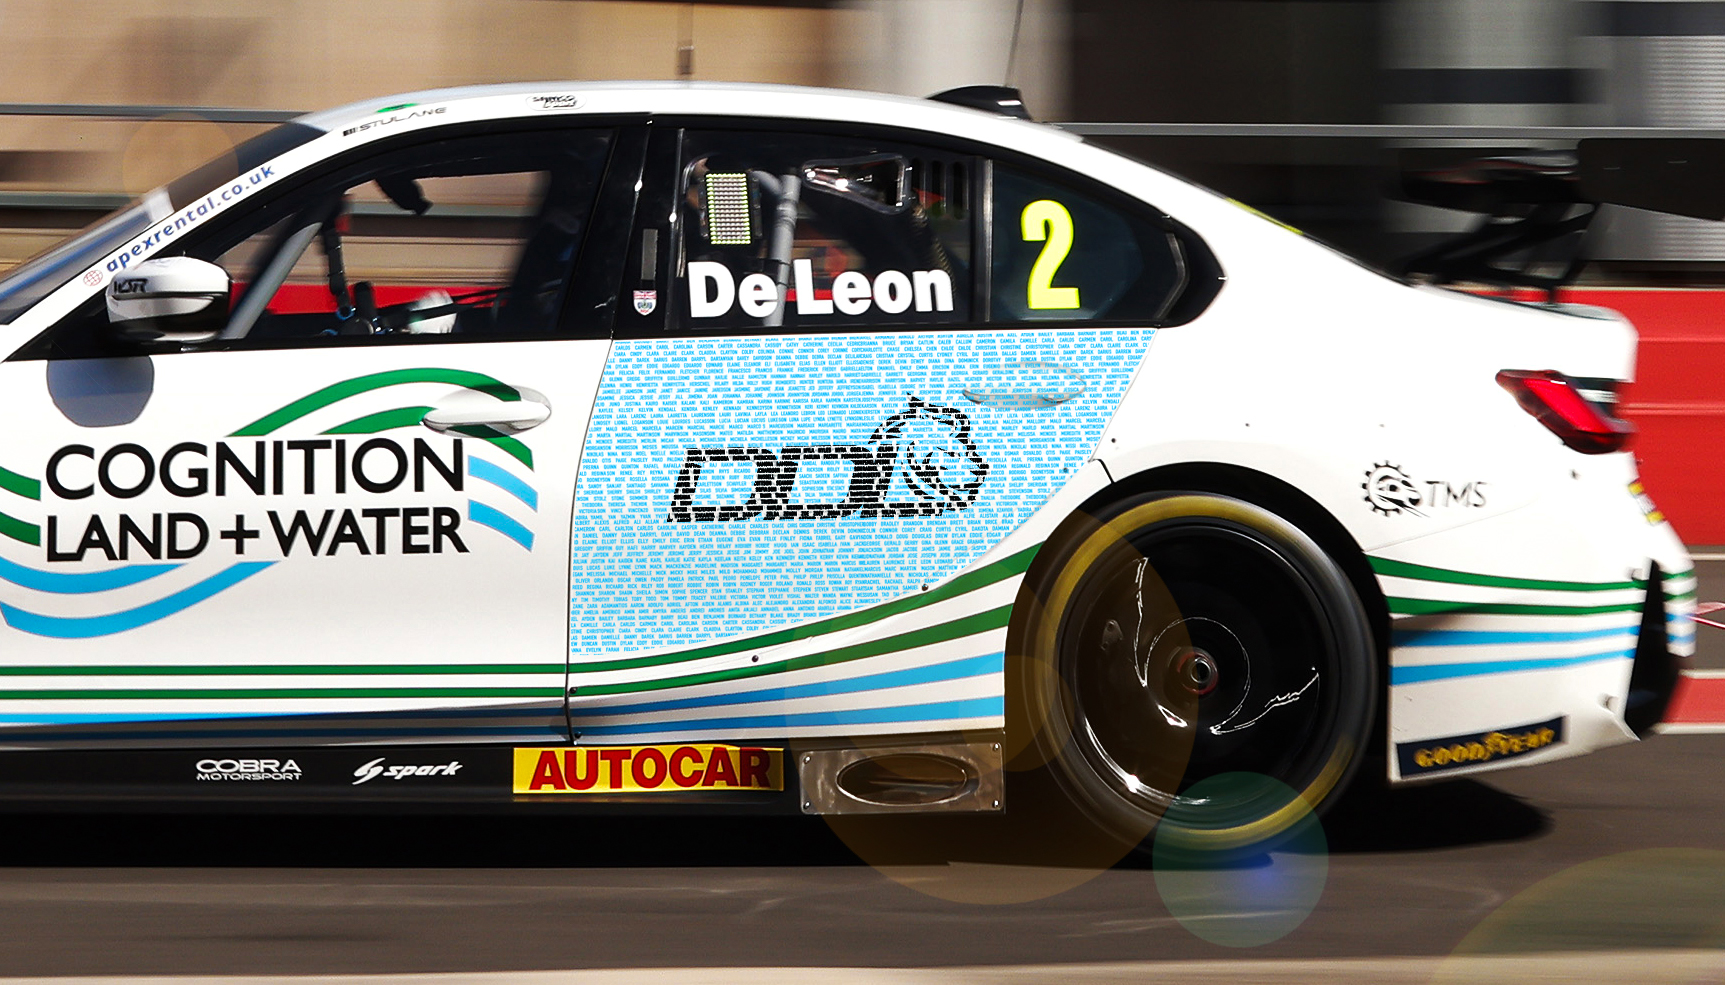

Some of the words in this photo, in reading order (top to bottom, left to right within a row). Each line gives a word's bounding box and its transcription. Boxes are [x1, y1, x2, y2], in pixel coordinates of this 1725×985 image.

[106, 165, 275, 273] apexrental.co.uk
[1021, 200, 1080, 309] 2
[688, 261, 778, 318] De
[793, 259, 953, 315] Leon
[46, 437, 465, 500] COGNITION
[1424, 479, 1489, 508] TMS
[47, 511, 210, 562] LAND
[220, 514, 260, 555] +
[267, 507, 471, 558] WATER
[195, 758, 303, 773] COBRA
[196, 773, 303, 782] MOTORSPORT
[382, 761, 464, 780] spark
[529, 745, 772, 792] AUTOCAR
